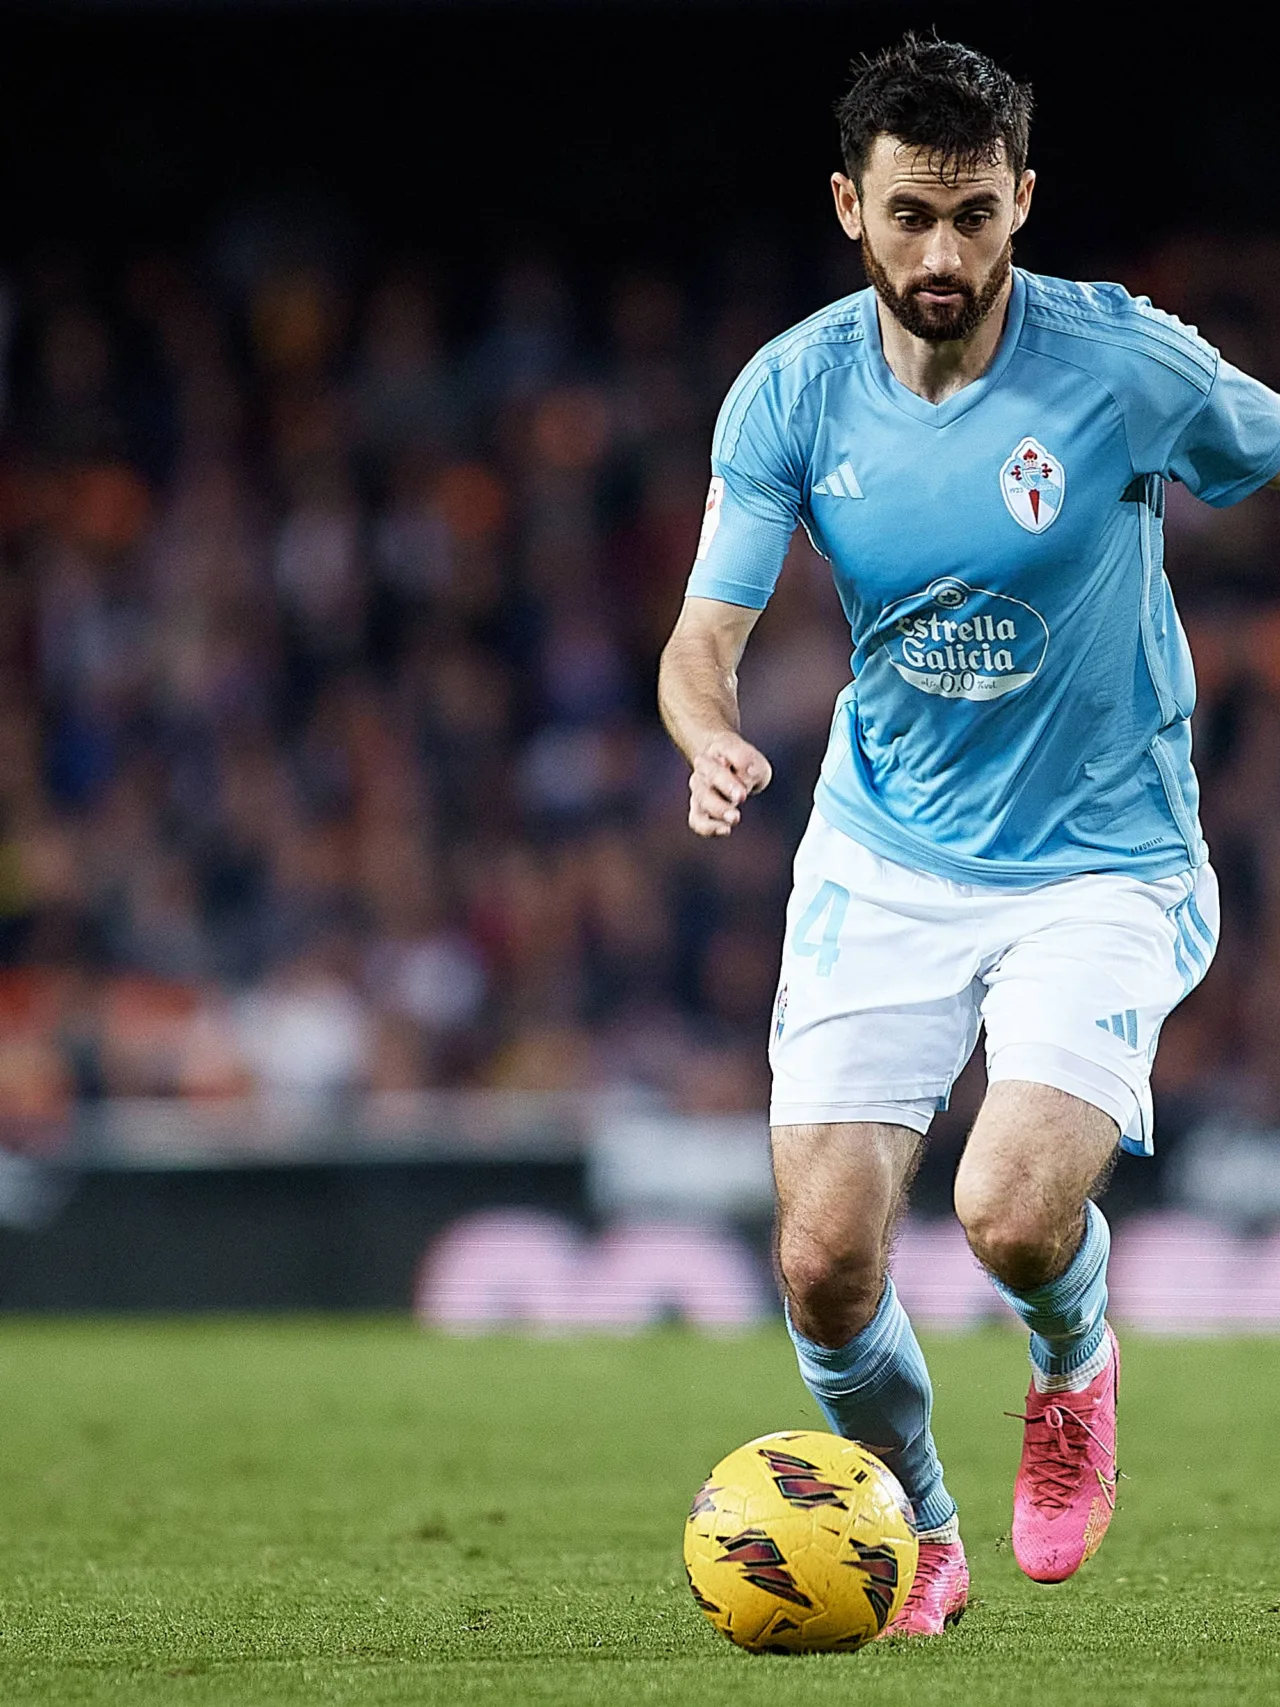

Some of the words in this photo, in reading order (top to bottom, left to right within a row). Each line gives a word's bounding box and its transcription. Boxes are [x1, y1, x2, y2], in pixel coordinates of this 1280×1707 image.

[896, 612, 1017, 642] Estrella
[902, 637, 1015, 671] Galicia
[940, 670, 975, 693] 0,0
[793, 880, 850, 976] 4
